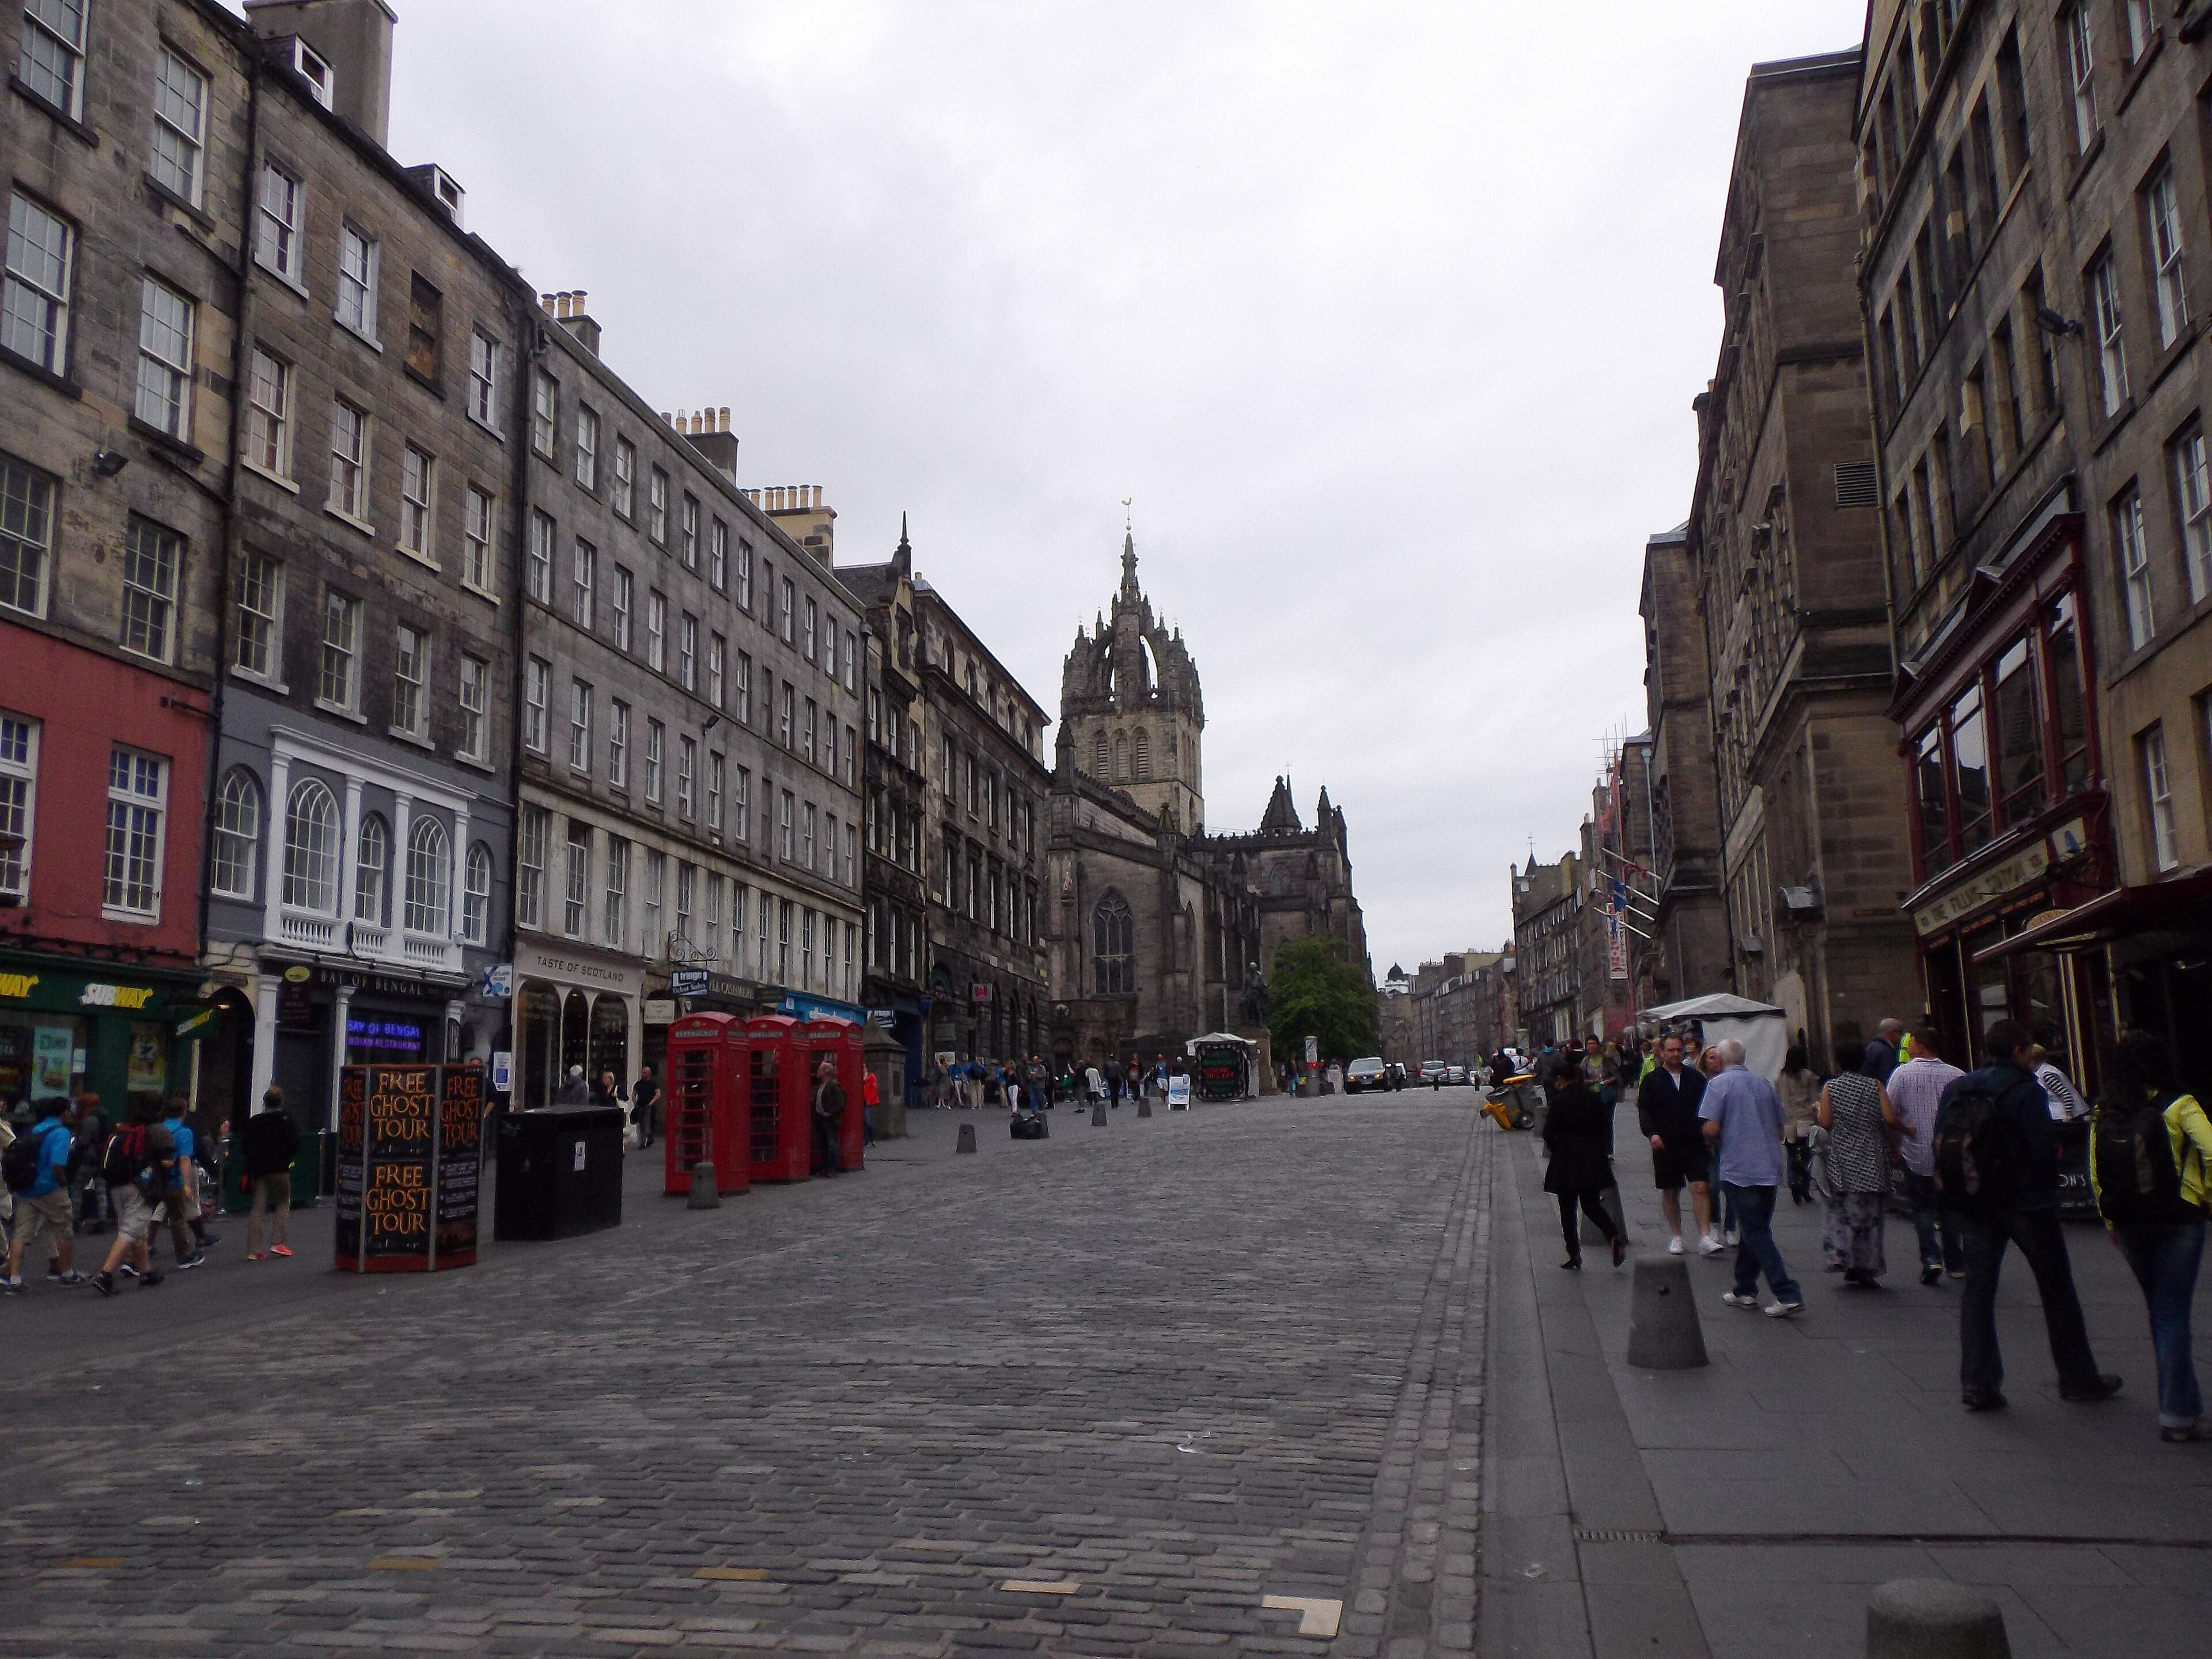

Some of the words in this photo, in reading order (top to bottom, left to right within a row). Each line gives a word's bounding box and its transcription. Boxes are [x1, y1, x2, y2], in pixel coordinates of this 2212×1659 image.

[537, 955, 563, 971] TASTE
[566, 962, 579, 972] OF
[581, 965, 624, 982] SCOTLAND
[320, 969, 345, 984] BAY
[352, 974, 368, 987] OF
[375, 978, 422, 995] BENGAL
[79, 983, 154, 1009] SUBWAY
[378, 1070, 426, 1096] FREE
[446, 1074, 478, 1098] FREE
[369, 1094, 434, 1118] GHOST
[440, 1098, 482, 1122] GHOST
[373, 1118, 430, 1141] TOUR
[442, 1120, 480, 1147] TOUR
[374, 1164, 423, 1187] FREE
[366, 1187, 431, 1210] GHOST
[370, 1212, 426, 1236] TOUR
